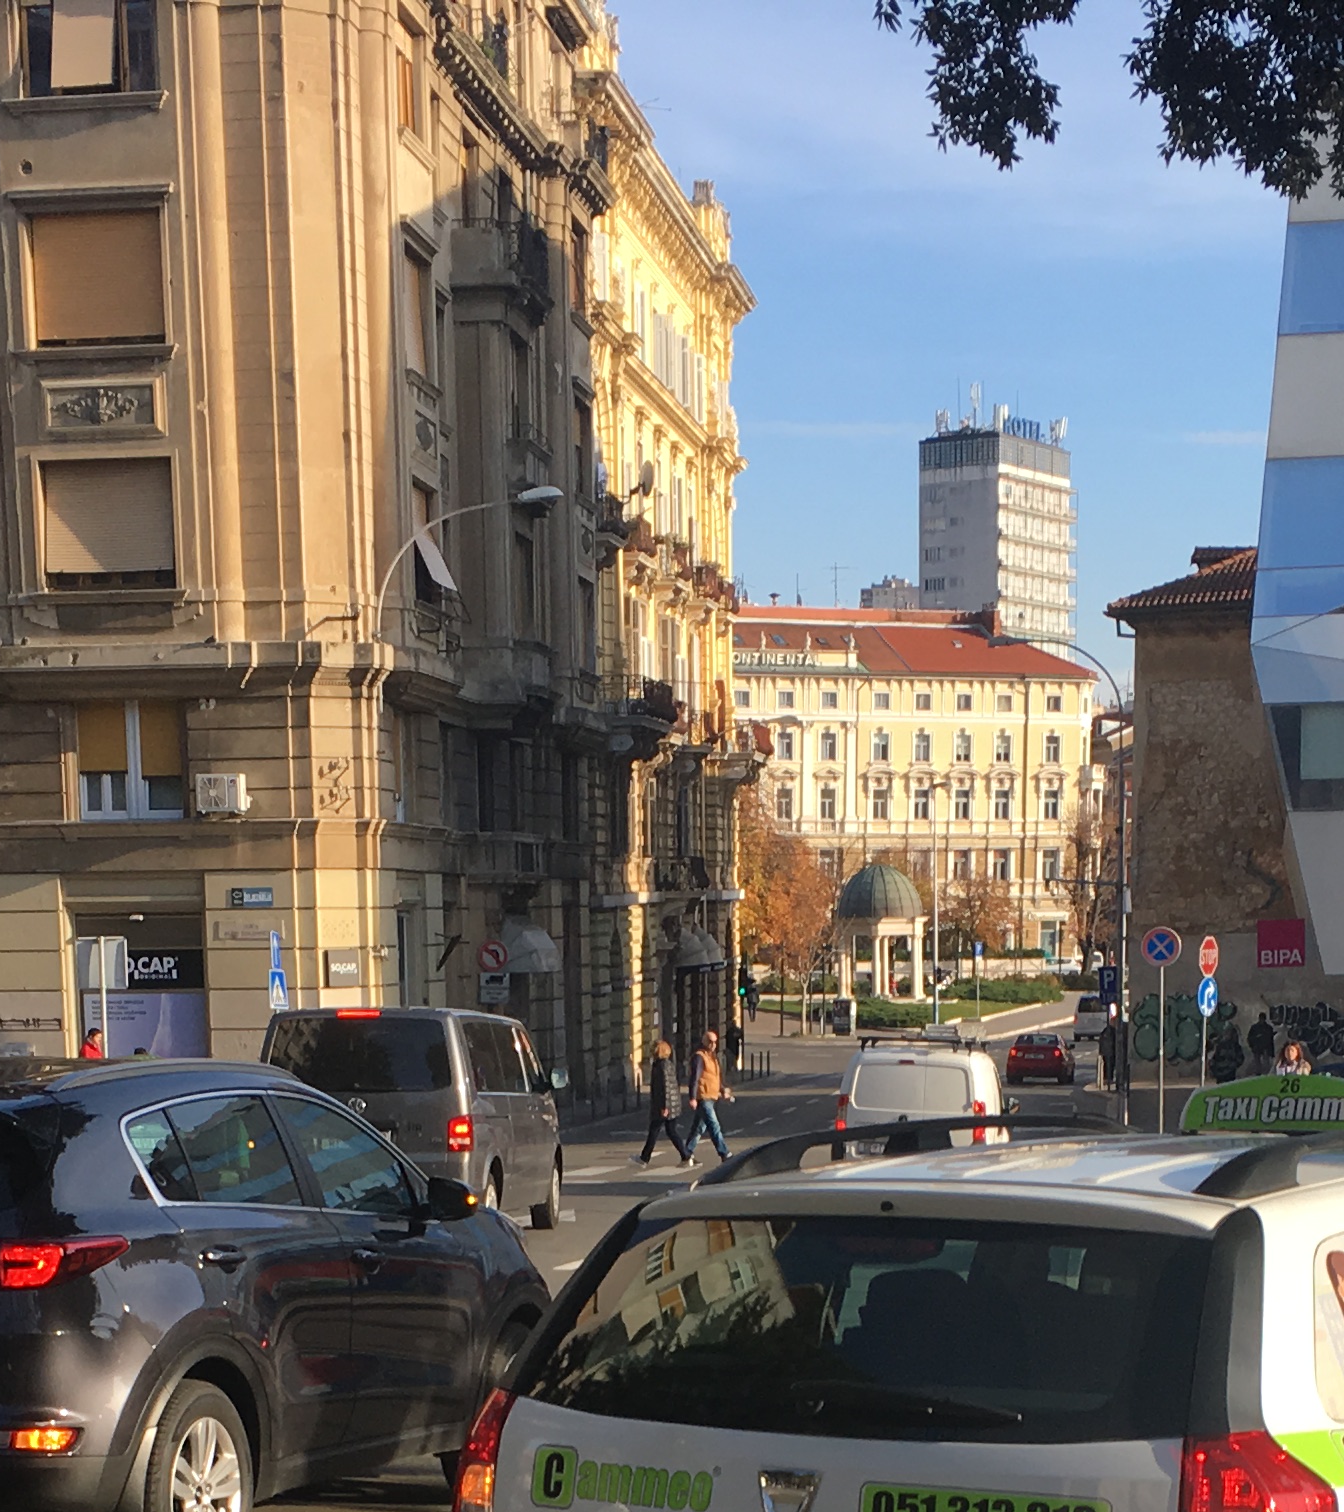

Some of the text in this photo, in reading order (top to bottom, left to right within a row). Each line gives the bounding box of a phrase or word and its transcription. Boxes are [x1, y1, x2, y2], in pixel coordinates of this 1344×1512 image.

[732, 651, 822, 666] ONTINENTAL
[1200, 948, 1218, 965] STOP
[1261, 949, 1302, 965] BIPA
[1103, 970, 1115, 989] P
[1280, 1078, 1301, 1094] 26
[543, 1452, 714, 1512] Cammeo
